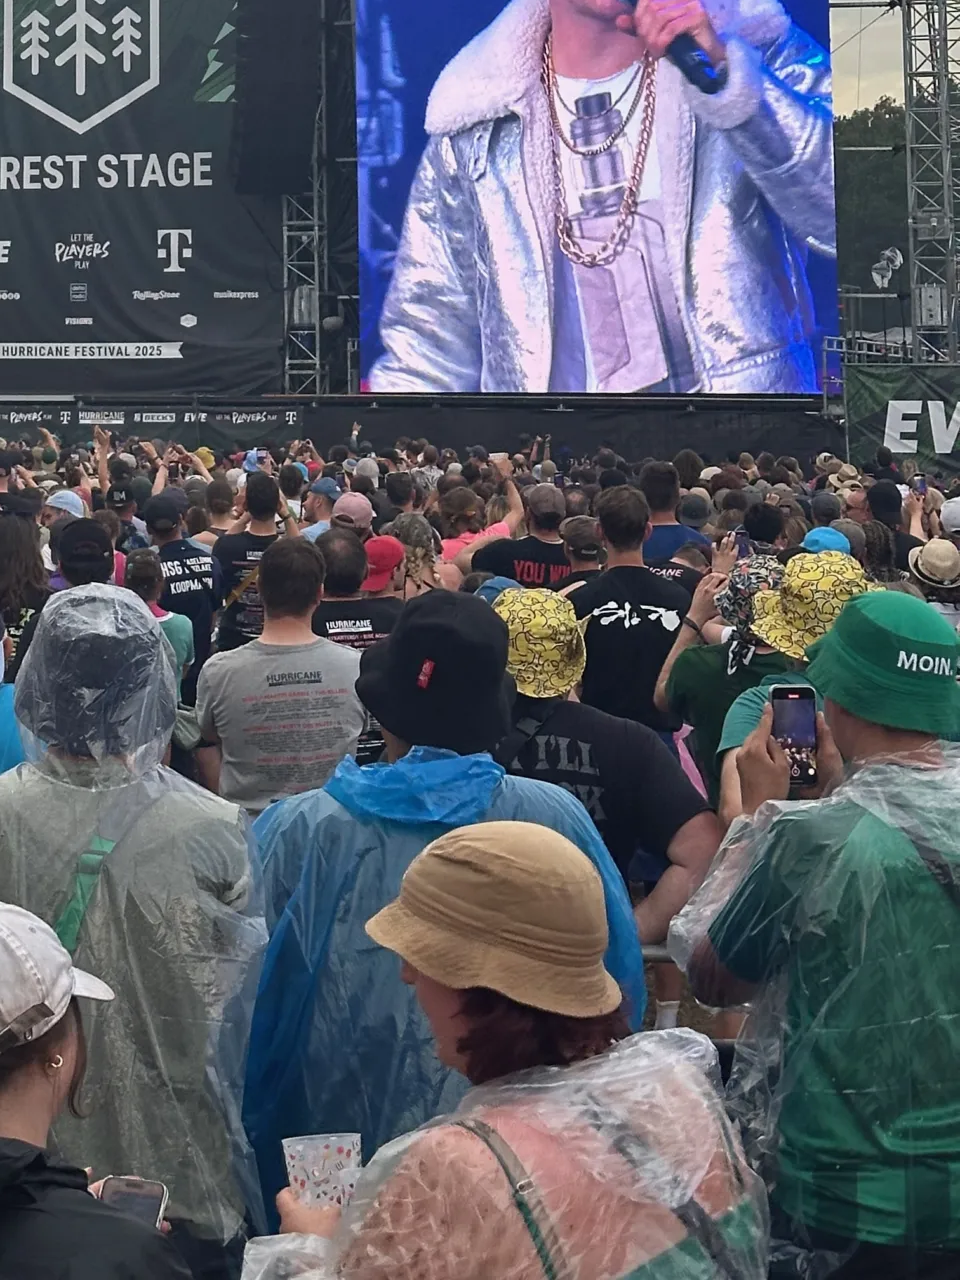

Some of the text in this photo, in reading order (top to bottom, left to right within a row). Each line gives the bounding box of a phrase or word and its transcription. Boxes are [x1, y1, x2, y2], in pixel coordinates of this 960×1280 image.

[97, 151, 213, 188] STAGE
[70, 233, 93, 242] LET THE
[55, 241, 110, 263] PLAYERS
[74, 261, 89, 270] PLAY
[1, 344, 163, 357] HURRICANE FESTIVAL 2025
[10, 411, 43, 424] PLAYERS
[79, 411, 125, 419] HURRICANE
[184, 413, 208, 422] EWE
[232, 411, 267, 424] PLAYERS
[160, 560, 183, 578] HSG
[514, 560, 546, 584] YOU
[326, 619, 372, 629] HURRICANE
[896, 650, 953, 676] MOIN.
[266, 671, 323, 682] HURRICANE
